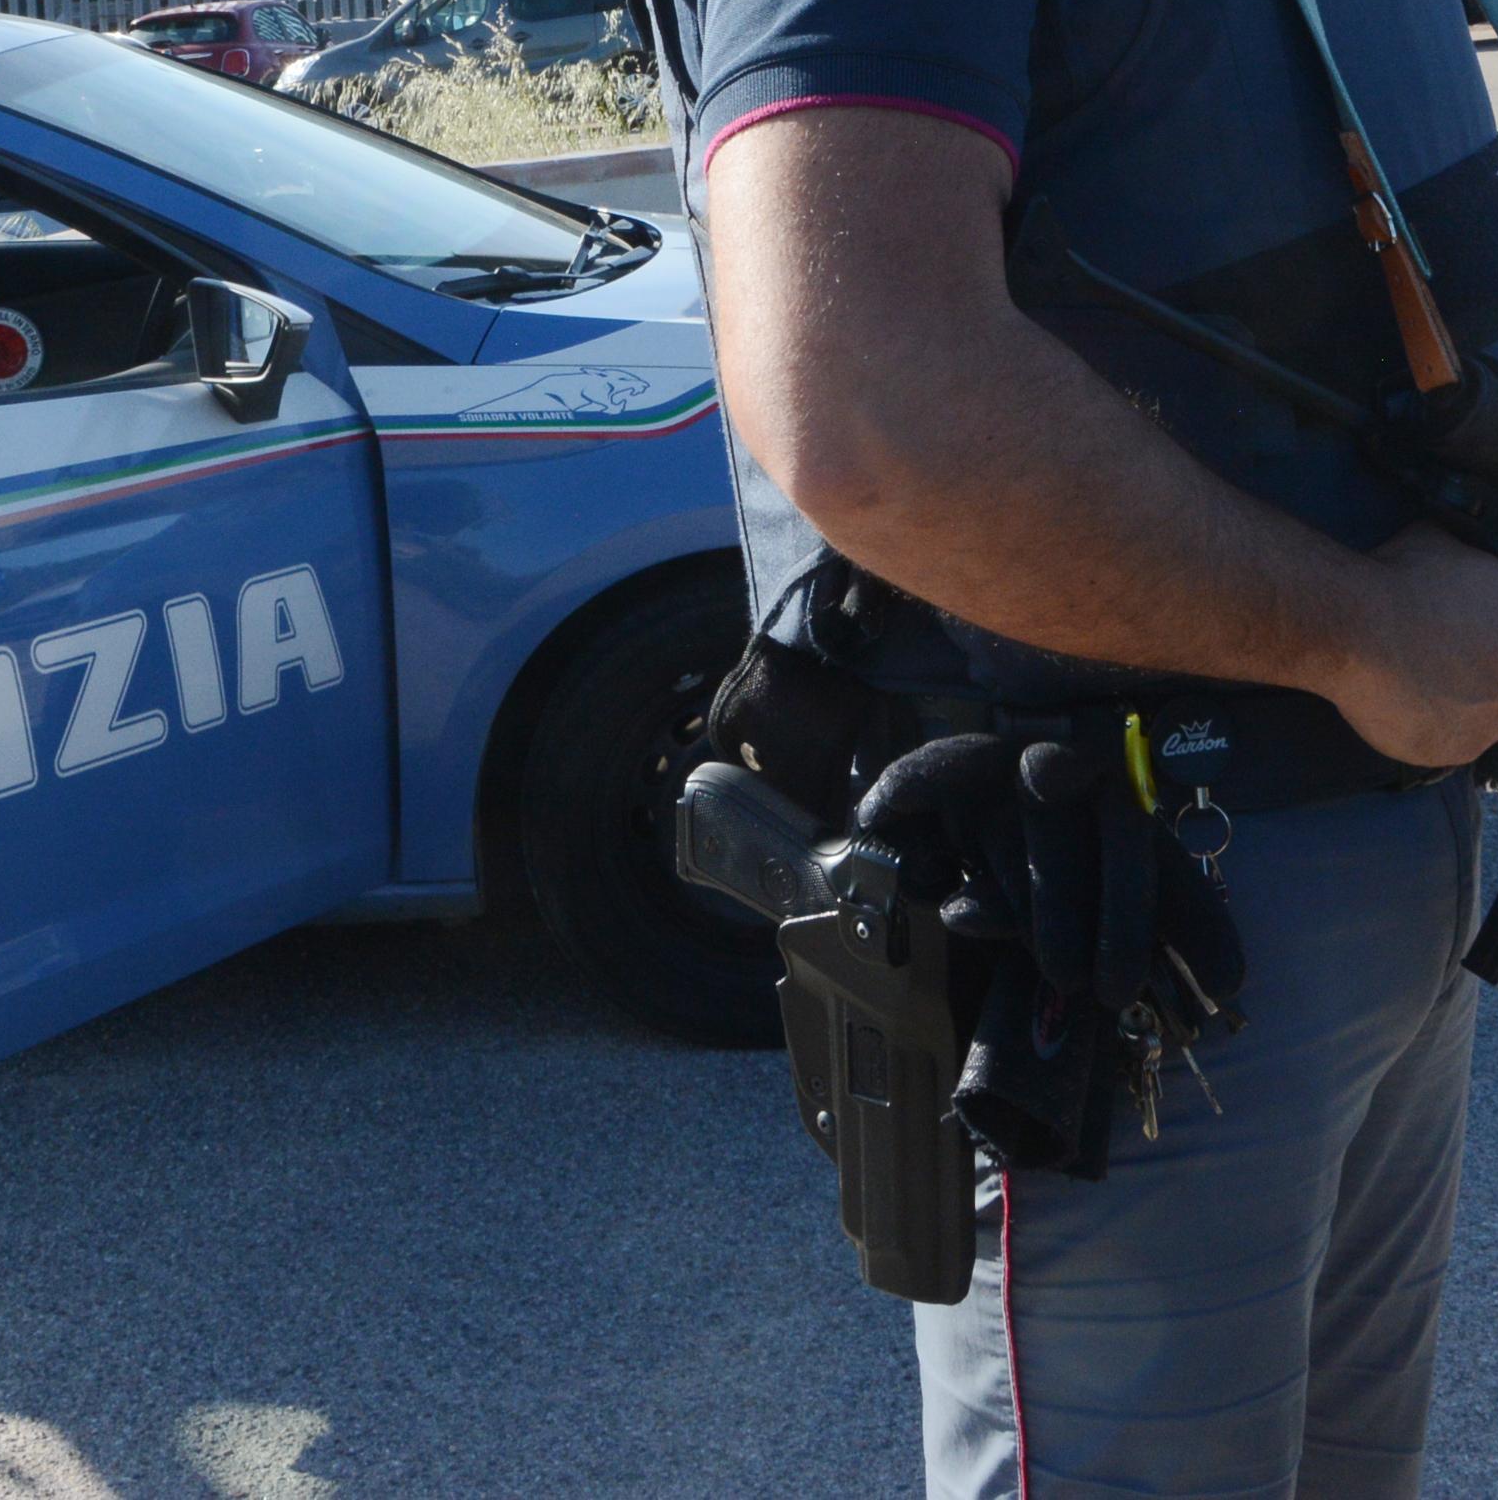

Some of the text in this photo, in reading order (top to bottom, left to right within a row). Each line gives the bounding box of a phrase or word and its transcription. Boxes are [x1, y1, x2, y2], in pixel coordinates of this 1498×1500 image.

[458, 410, 576, 423] SQUADRA VOLANTE
[1161, 731, 1230, 757] Carson
